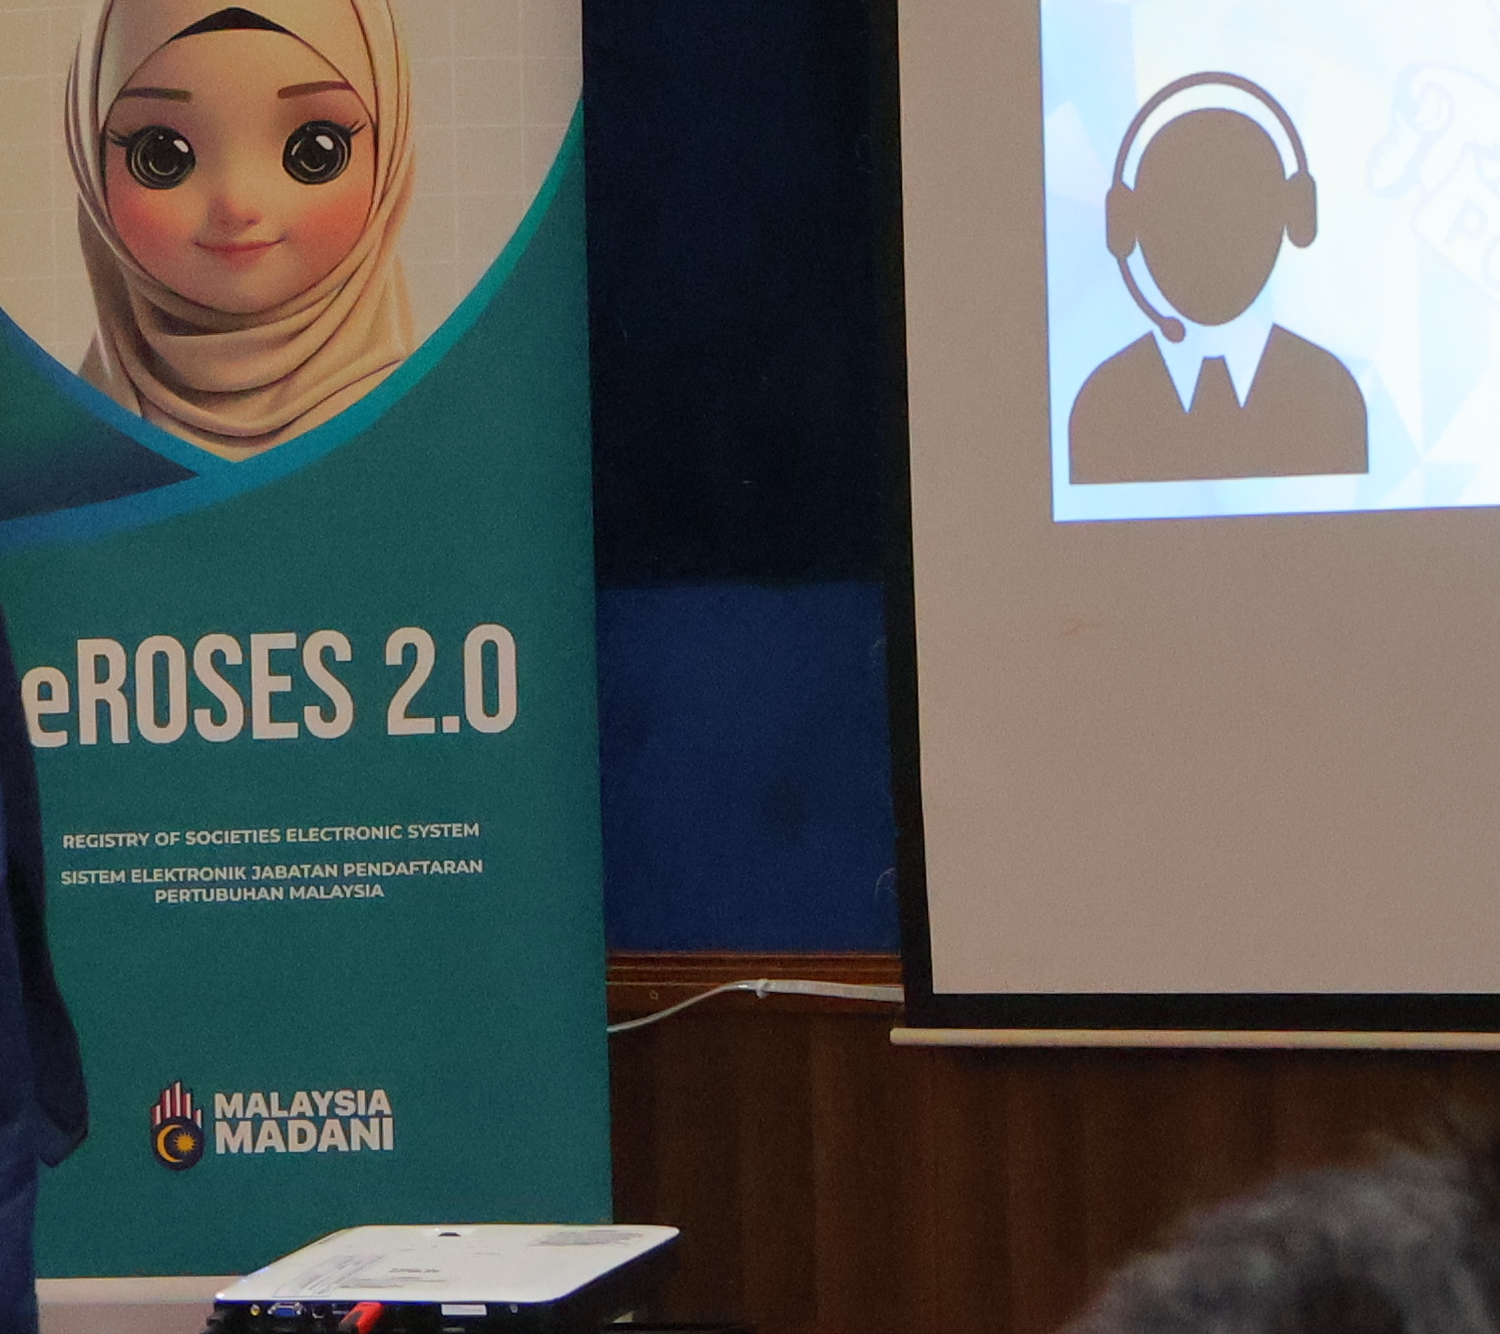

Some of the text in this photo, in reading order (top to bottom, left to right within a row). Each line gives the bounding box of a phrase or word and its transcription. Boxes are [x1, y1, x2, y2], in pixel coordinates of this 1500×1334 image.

[20, 622, 519, 749] eROSES 2.0
[62, 822, 481, 850] REGISTRY OF SOCIETIES ELECTRONIC SYSTEM
[61, 859, 484, 886] SISTEM ELEKTRONIK JABATAN PENDAFTARAN
[155, 883, 385, 905] PERTUBUHAN MALAYSIA
[213, 1089, 393, 1119] MALAYSIA
[214, 1117, 395, 1155] MADANI
